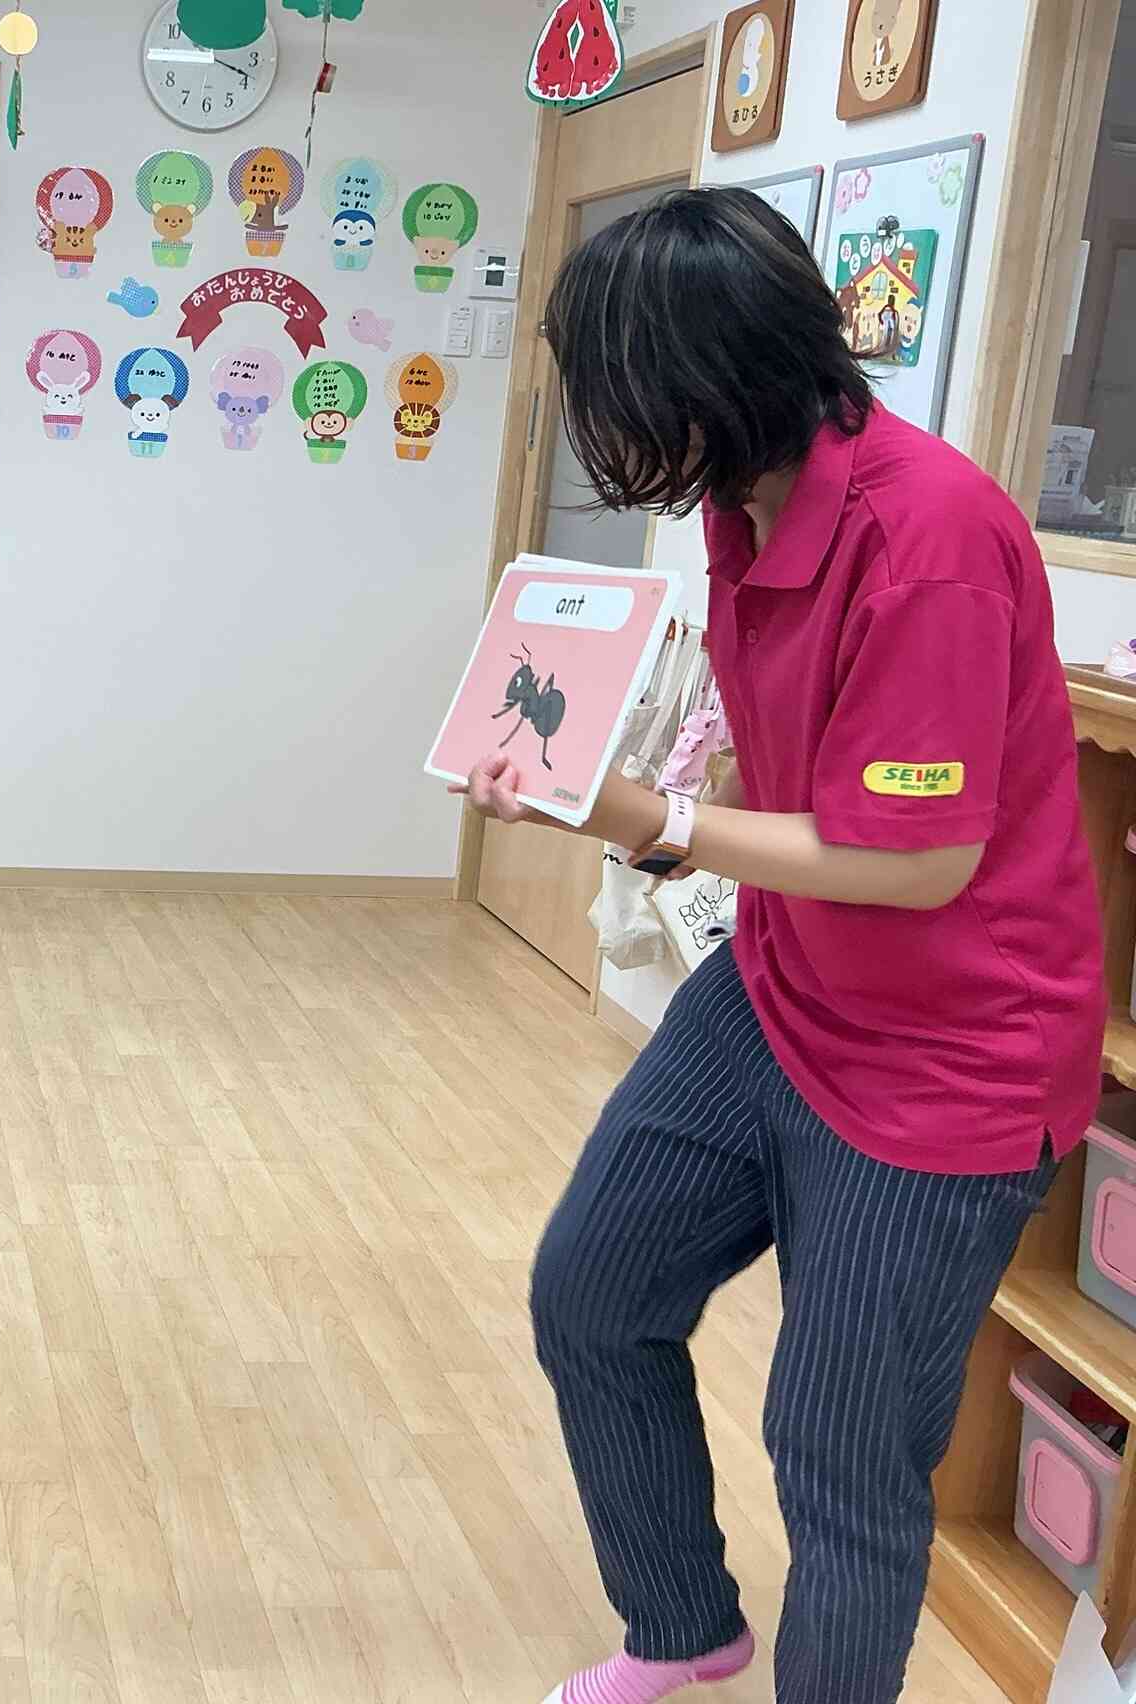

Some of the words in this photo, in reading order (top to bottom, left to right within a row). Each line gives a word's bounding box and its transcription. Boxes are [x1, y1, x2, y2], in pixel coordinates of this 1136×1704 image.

[168, 22, 182, 40] 10
[248, 51, 259, 68] 3
[165, 71, 176, 88] 8
[239, 75, 249, 90] 4
[864, 63, 900, 88] うさぎ
[181, 89, 191, 106] 7
[202, 97, 212, 113] 6
[224, 92, 234, 108] 5
[732, 104, 759, 124] あひる
[191, 271, 293, 307] おたんじょうび
[230, 286, 309, 320] おめでとう
[555, 594, 585, 616] ant
[884, 767, 950, 782] SEIHA
